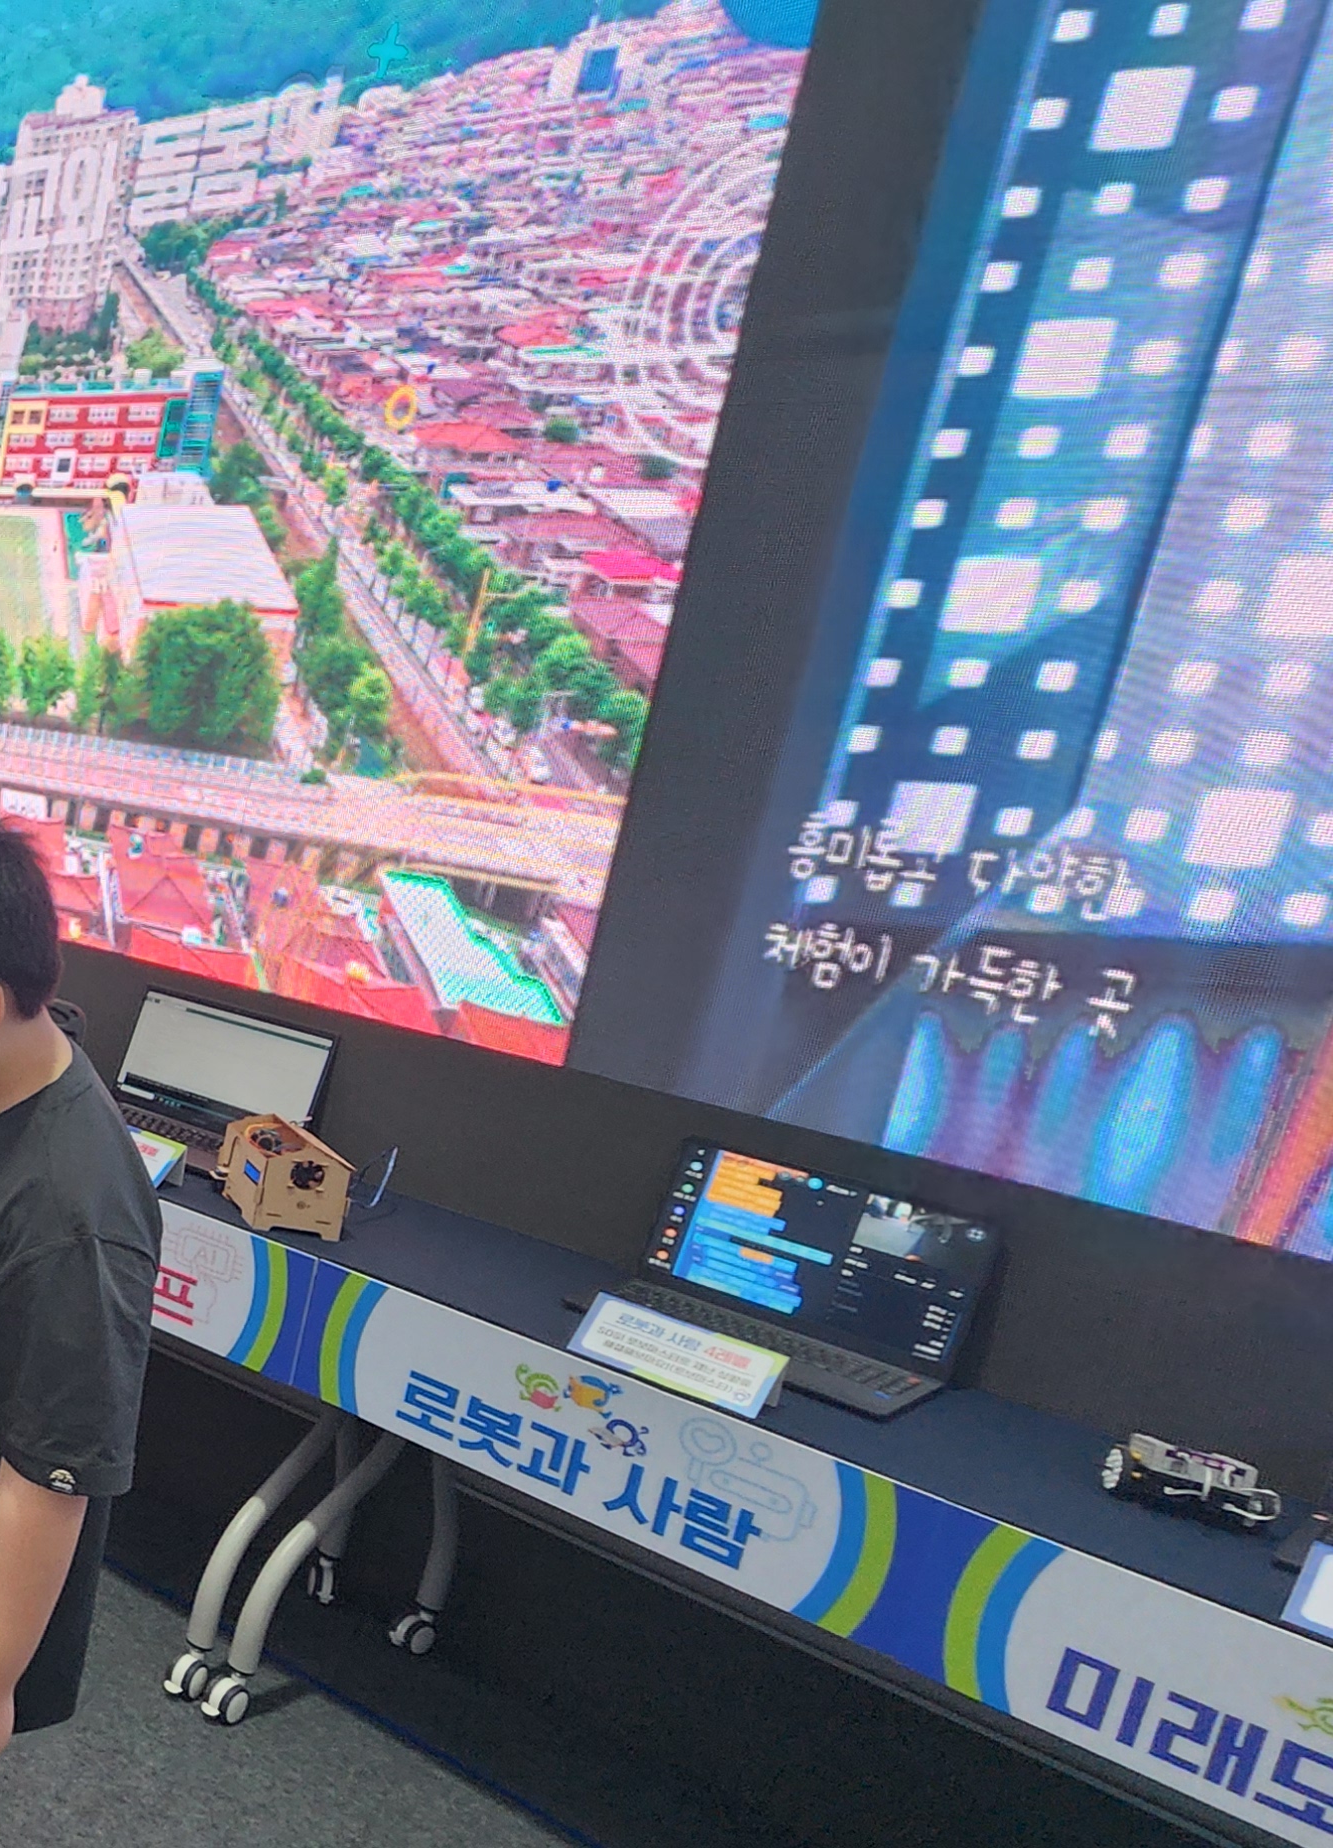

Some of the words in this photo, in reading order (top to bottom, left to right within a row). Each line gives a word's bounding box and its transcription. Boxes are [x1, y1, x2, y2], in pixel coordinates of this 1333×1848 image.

[787, 809, 948, 892] 흥미롭고
[967, 843, 1135, 922] 다양한
[764, 922, 893, 990] 체험이
[913, 945, 1064, 1025] 가득한
[1086, 968, 1136, 1039] 곳
[394, 1369, 592, 1497] 로봇과
[602, 1460, 764, 1571] 사람
